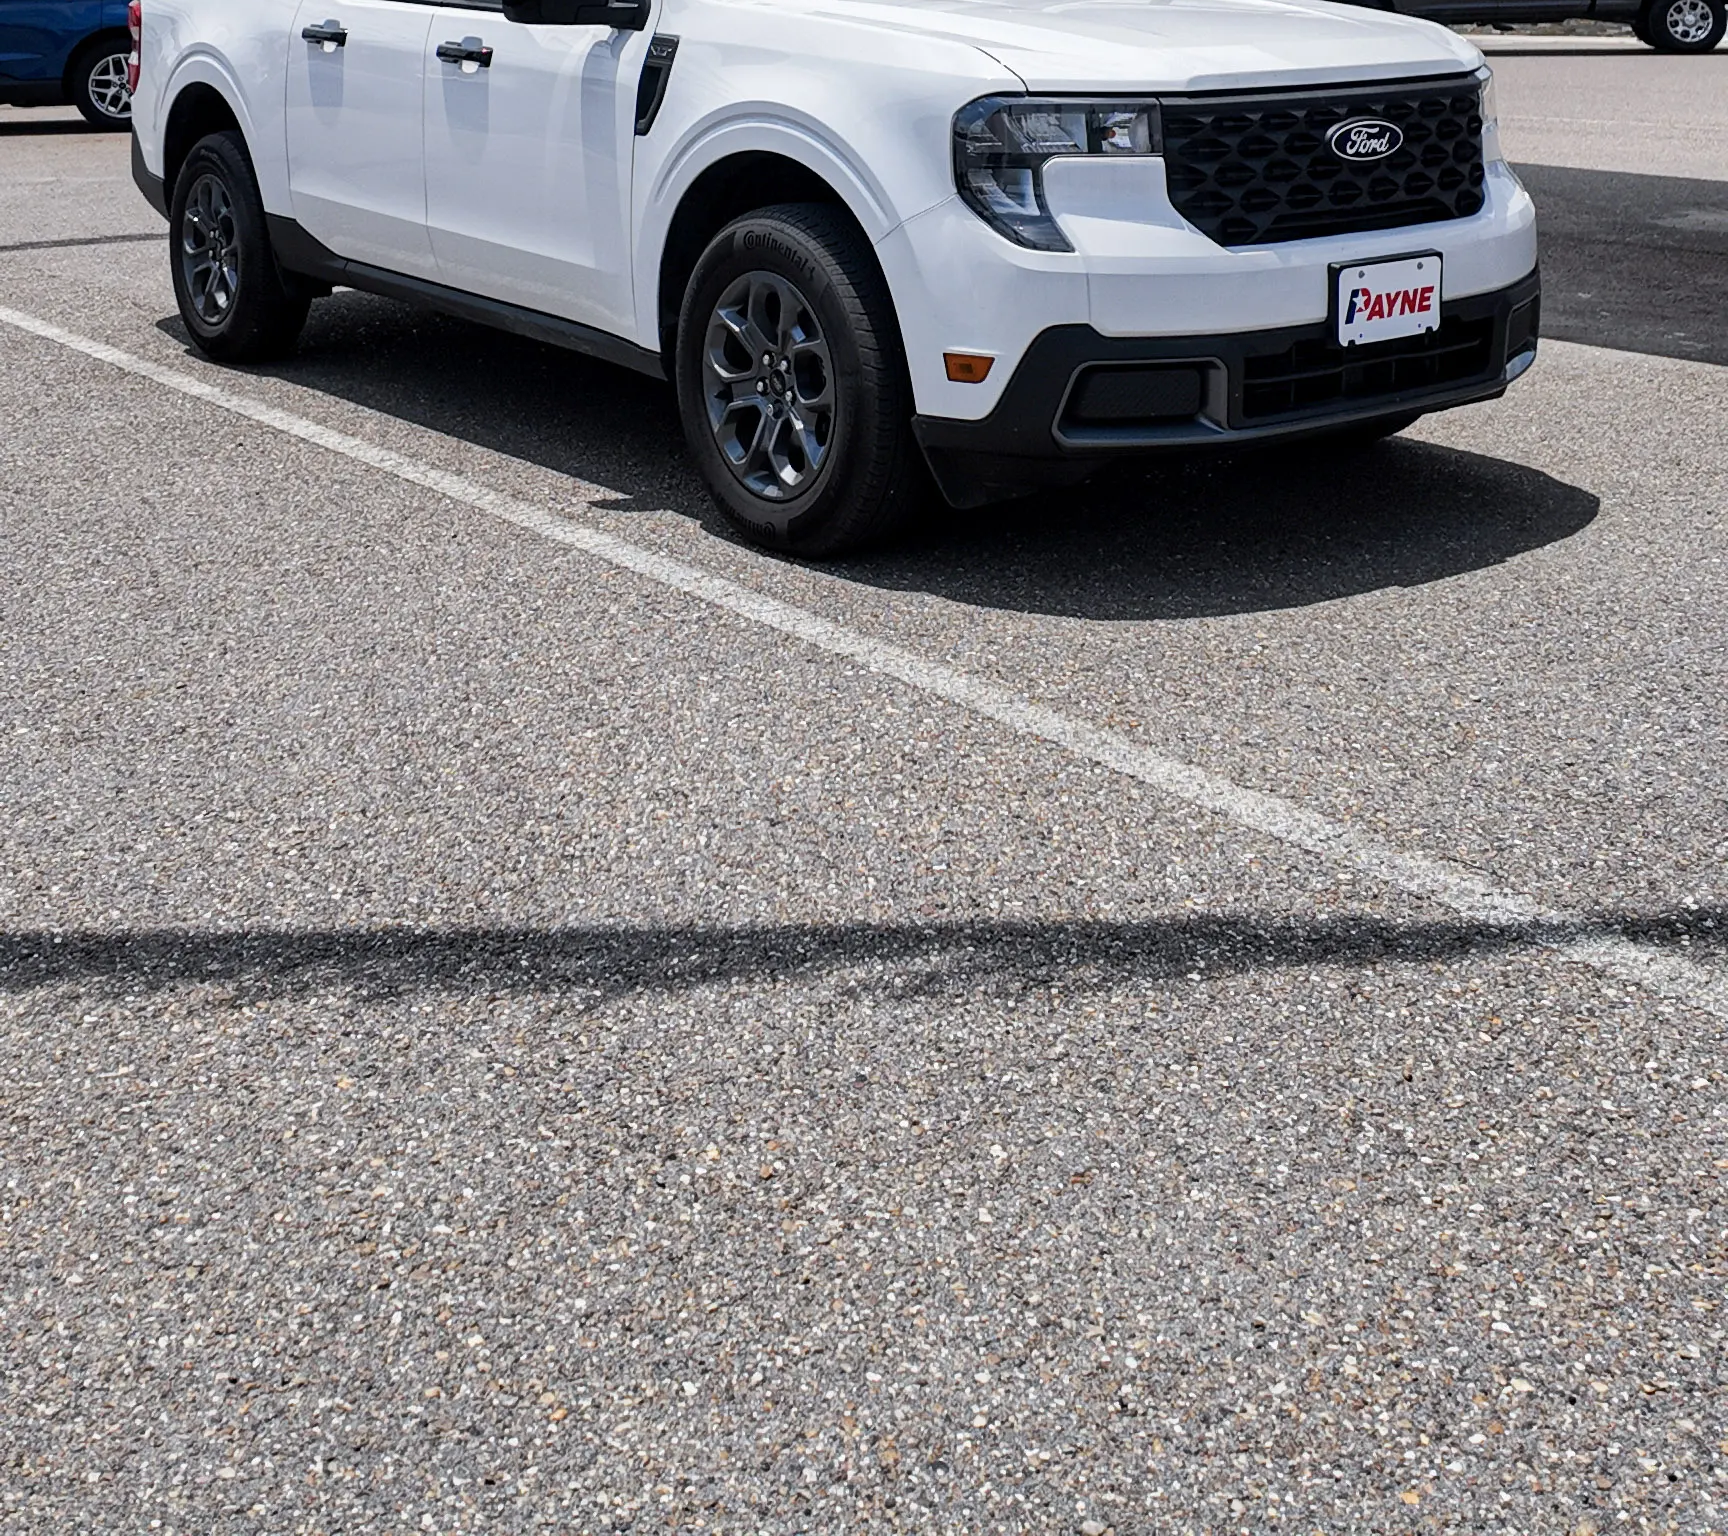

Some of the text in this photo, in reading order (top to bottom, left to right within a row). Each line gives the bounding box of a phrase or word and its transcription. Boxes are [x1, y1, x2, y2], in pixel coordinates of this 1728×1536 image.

[1346, 126, 1390, 155] Ford
[744, 230, 808, 272] Continental
[1345, 286, 1434, 324] PAYNE
